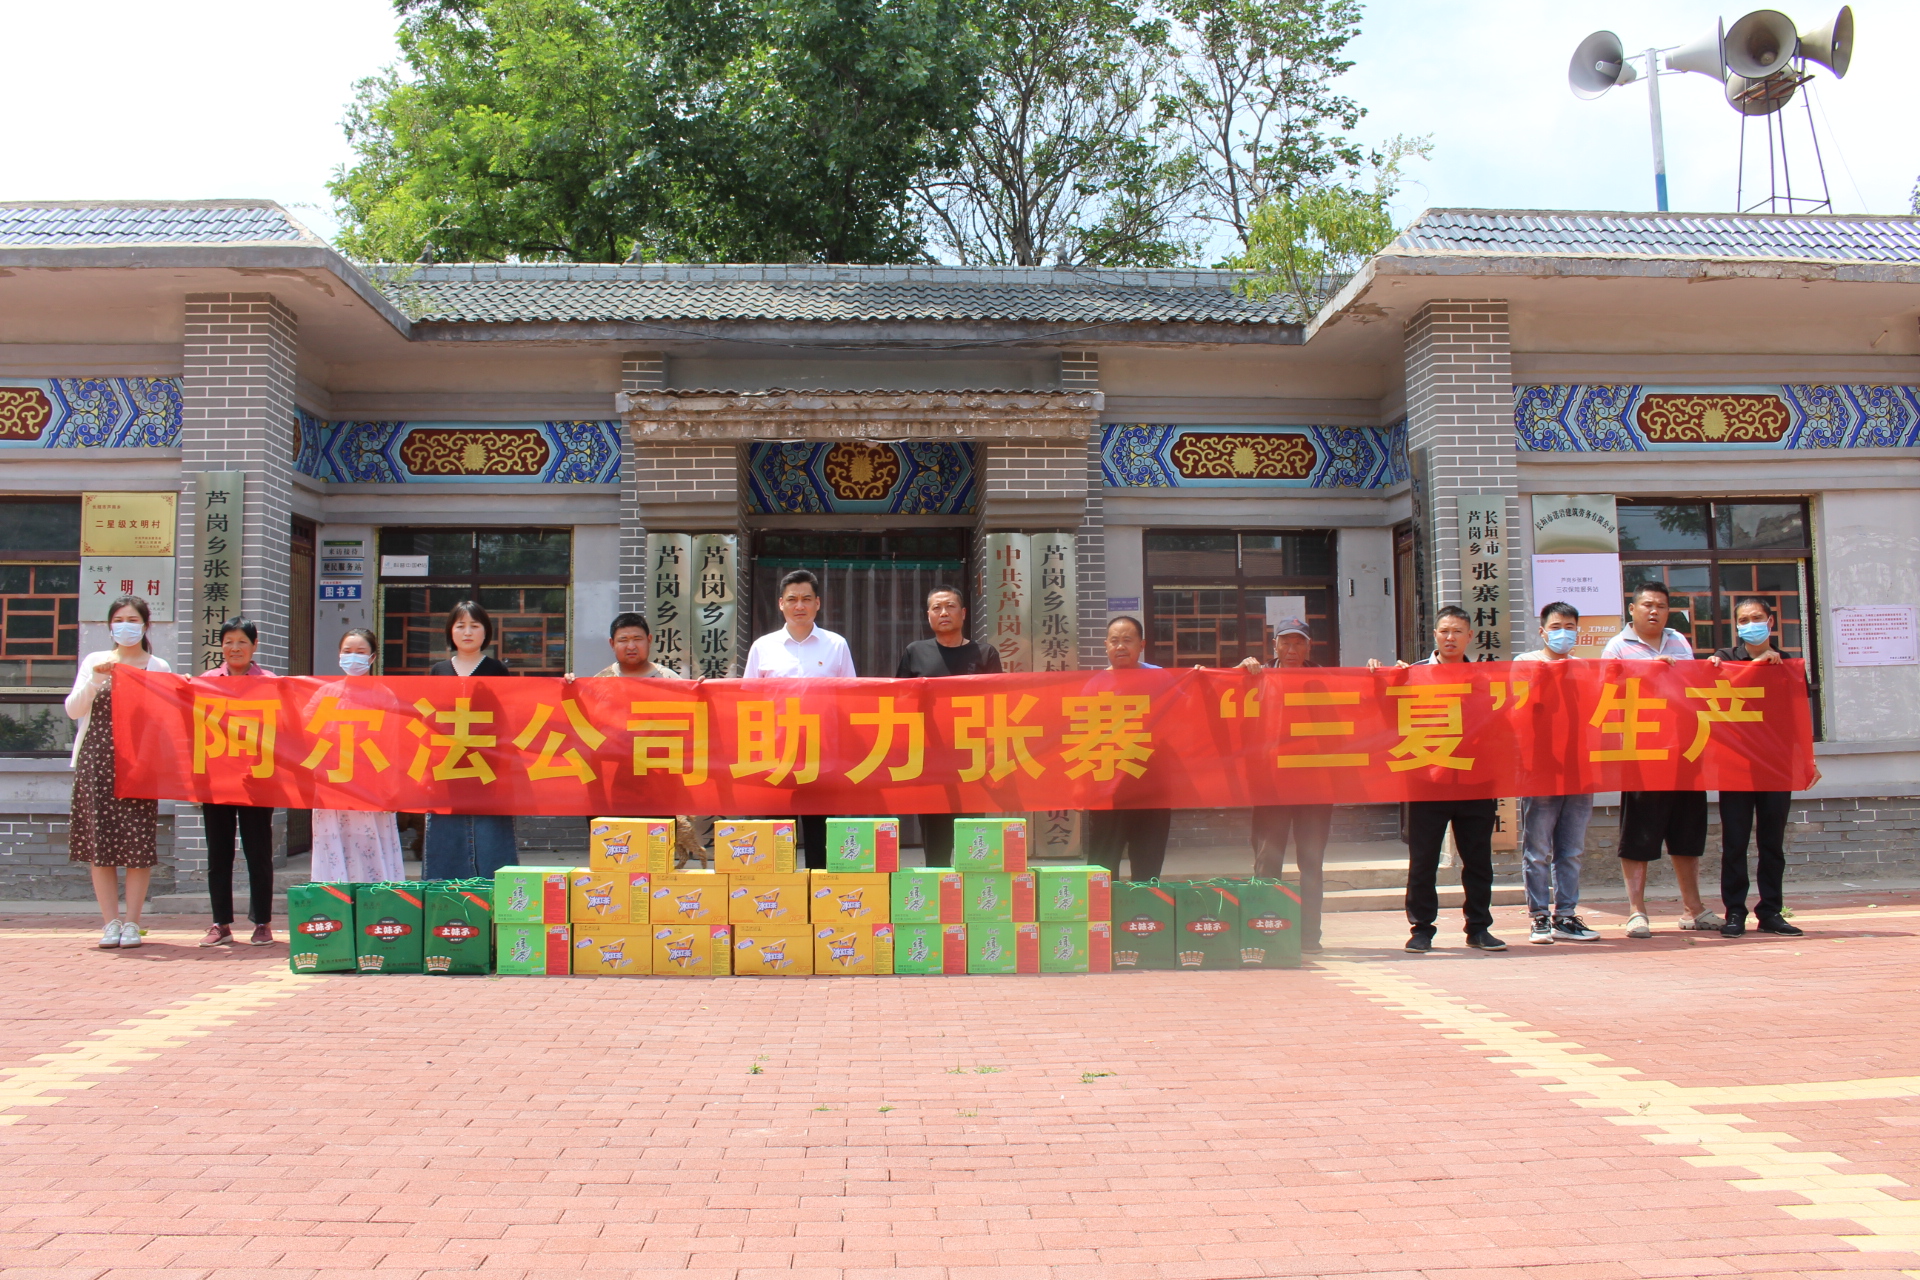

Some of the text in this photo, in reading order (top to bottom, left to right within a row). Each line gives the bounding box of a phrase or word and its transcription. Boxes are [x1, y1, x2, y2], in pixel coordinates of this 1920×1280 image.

[95, 519, 161, 529] 二星级文明村
[1467, 510, 1482, 556] 芦岗乡
[1484, 510, 1500, 555] 长垣市
[328, 548, 358, 556] 来访接待
[200, 490, 230, 670] 芦岗乡张寨村退役
[323, 562, 362, 572] 便民服务站
[325, 585, 356, 598] 图书室
[699, 545, 729, 679] 芦岗乡张寨
